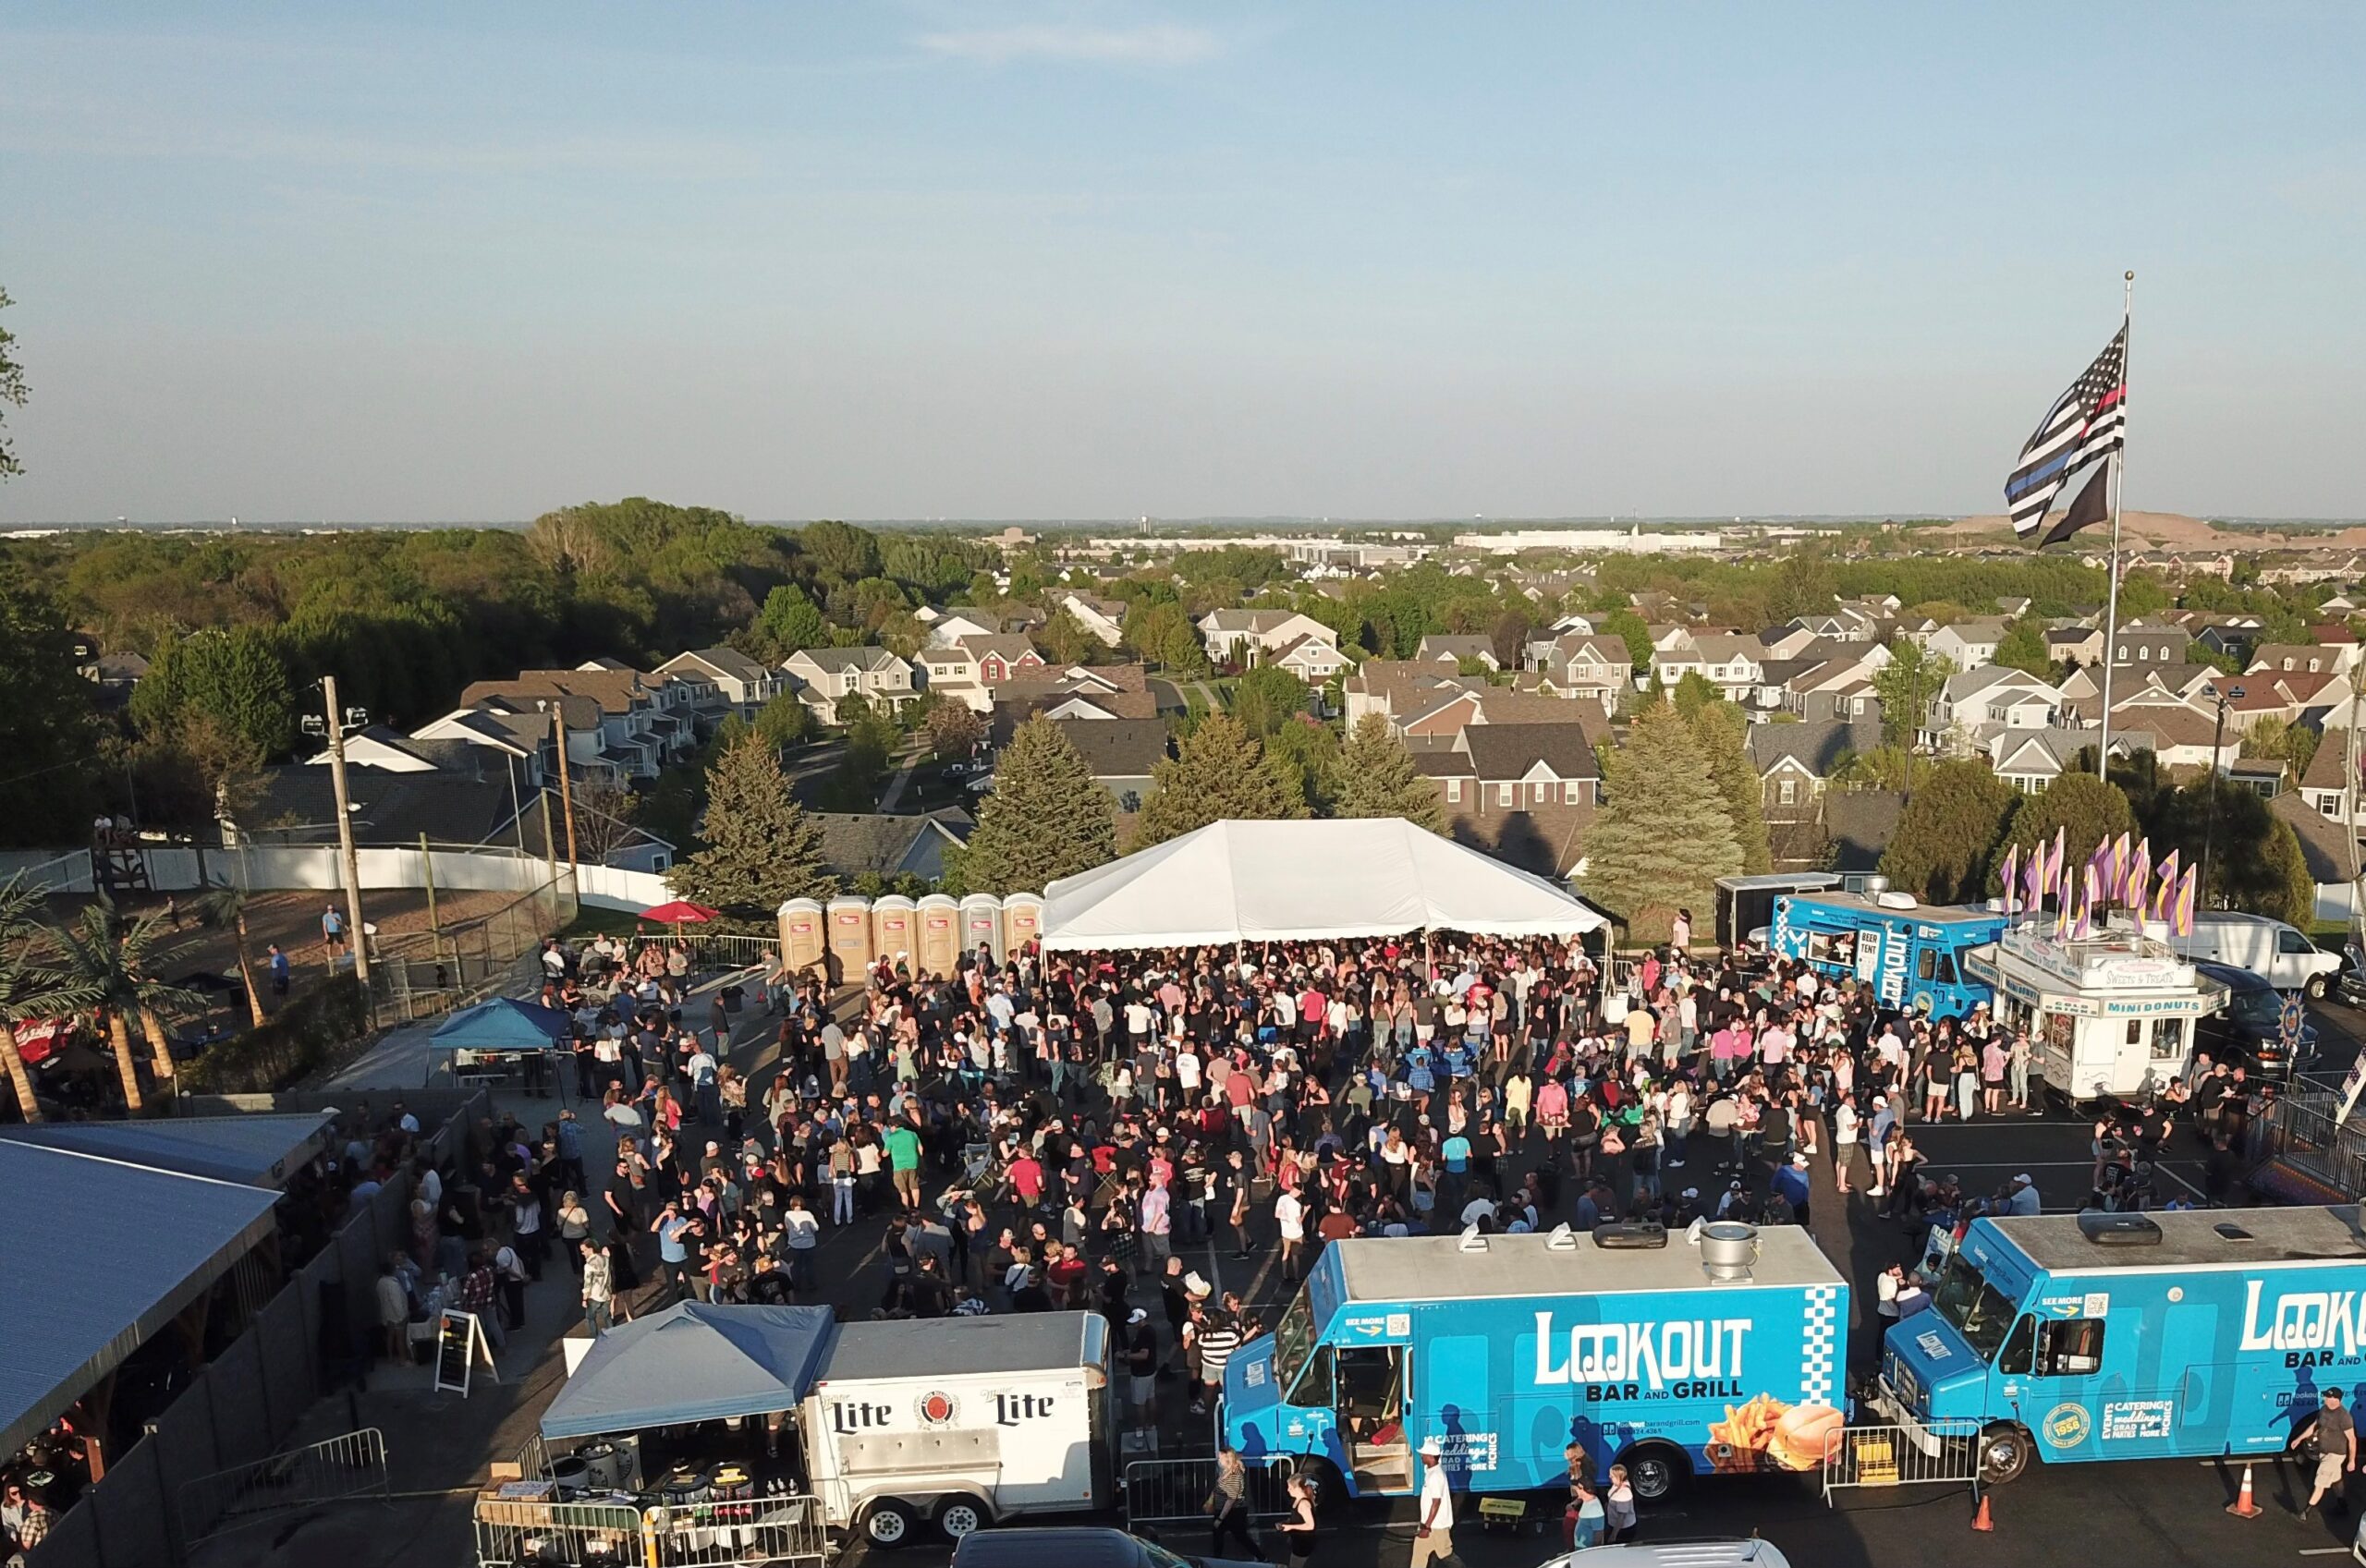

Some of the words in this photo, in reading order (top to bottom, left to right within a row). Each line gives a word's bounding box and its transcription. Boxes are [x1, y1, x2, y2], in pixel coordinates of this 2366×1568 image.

[1861, 932, 1877, 943] BEER
[1860, 943, 1876, 954] TENT
[2106, 970, 2136, 985] SWEETS
[2146, 971, 2175, 984] TREATS
[2107, 1003, 2141, 1013] MINI
[2143, 1001, 2201, 1012] DONUTS
[2057, 1296, 2083, 1305] MORE
[1360, 1317, 1385, 1325] MORE
[1534, 1311, 1752, 1390] LOOKOUT
[2285, 1350, 2335, 1367] BAR
[2337, 1356, 2361, 1367] AND
[1586, 1383, 1640, 1402] BAR
[1644, 1390, 1669, 1400] AND
[1673, 1380, 1744, 1399] GRILL
[995, 1394, 1055, 1427] Lite
[2115, 1401, 2164, 1411] CATERING
[831, 1403, 892, 1435] Lite
[2102, 1403, 2114, 1440] EVENTS
[2161, 1400, 2174, 1438] PICNICS
[2054, 1419, 2080, 1437] 1958
[2112, 1430, 2137, 1439] PARTIES
[2140, 1429, 2161, 1438] MORE
[1434, 1432, 1488, 1444] CATERING
[1488, 1432, 1497, 1471] PICNICS
[1465, 1463, 1487, 1471] MORE
